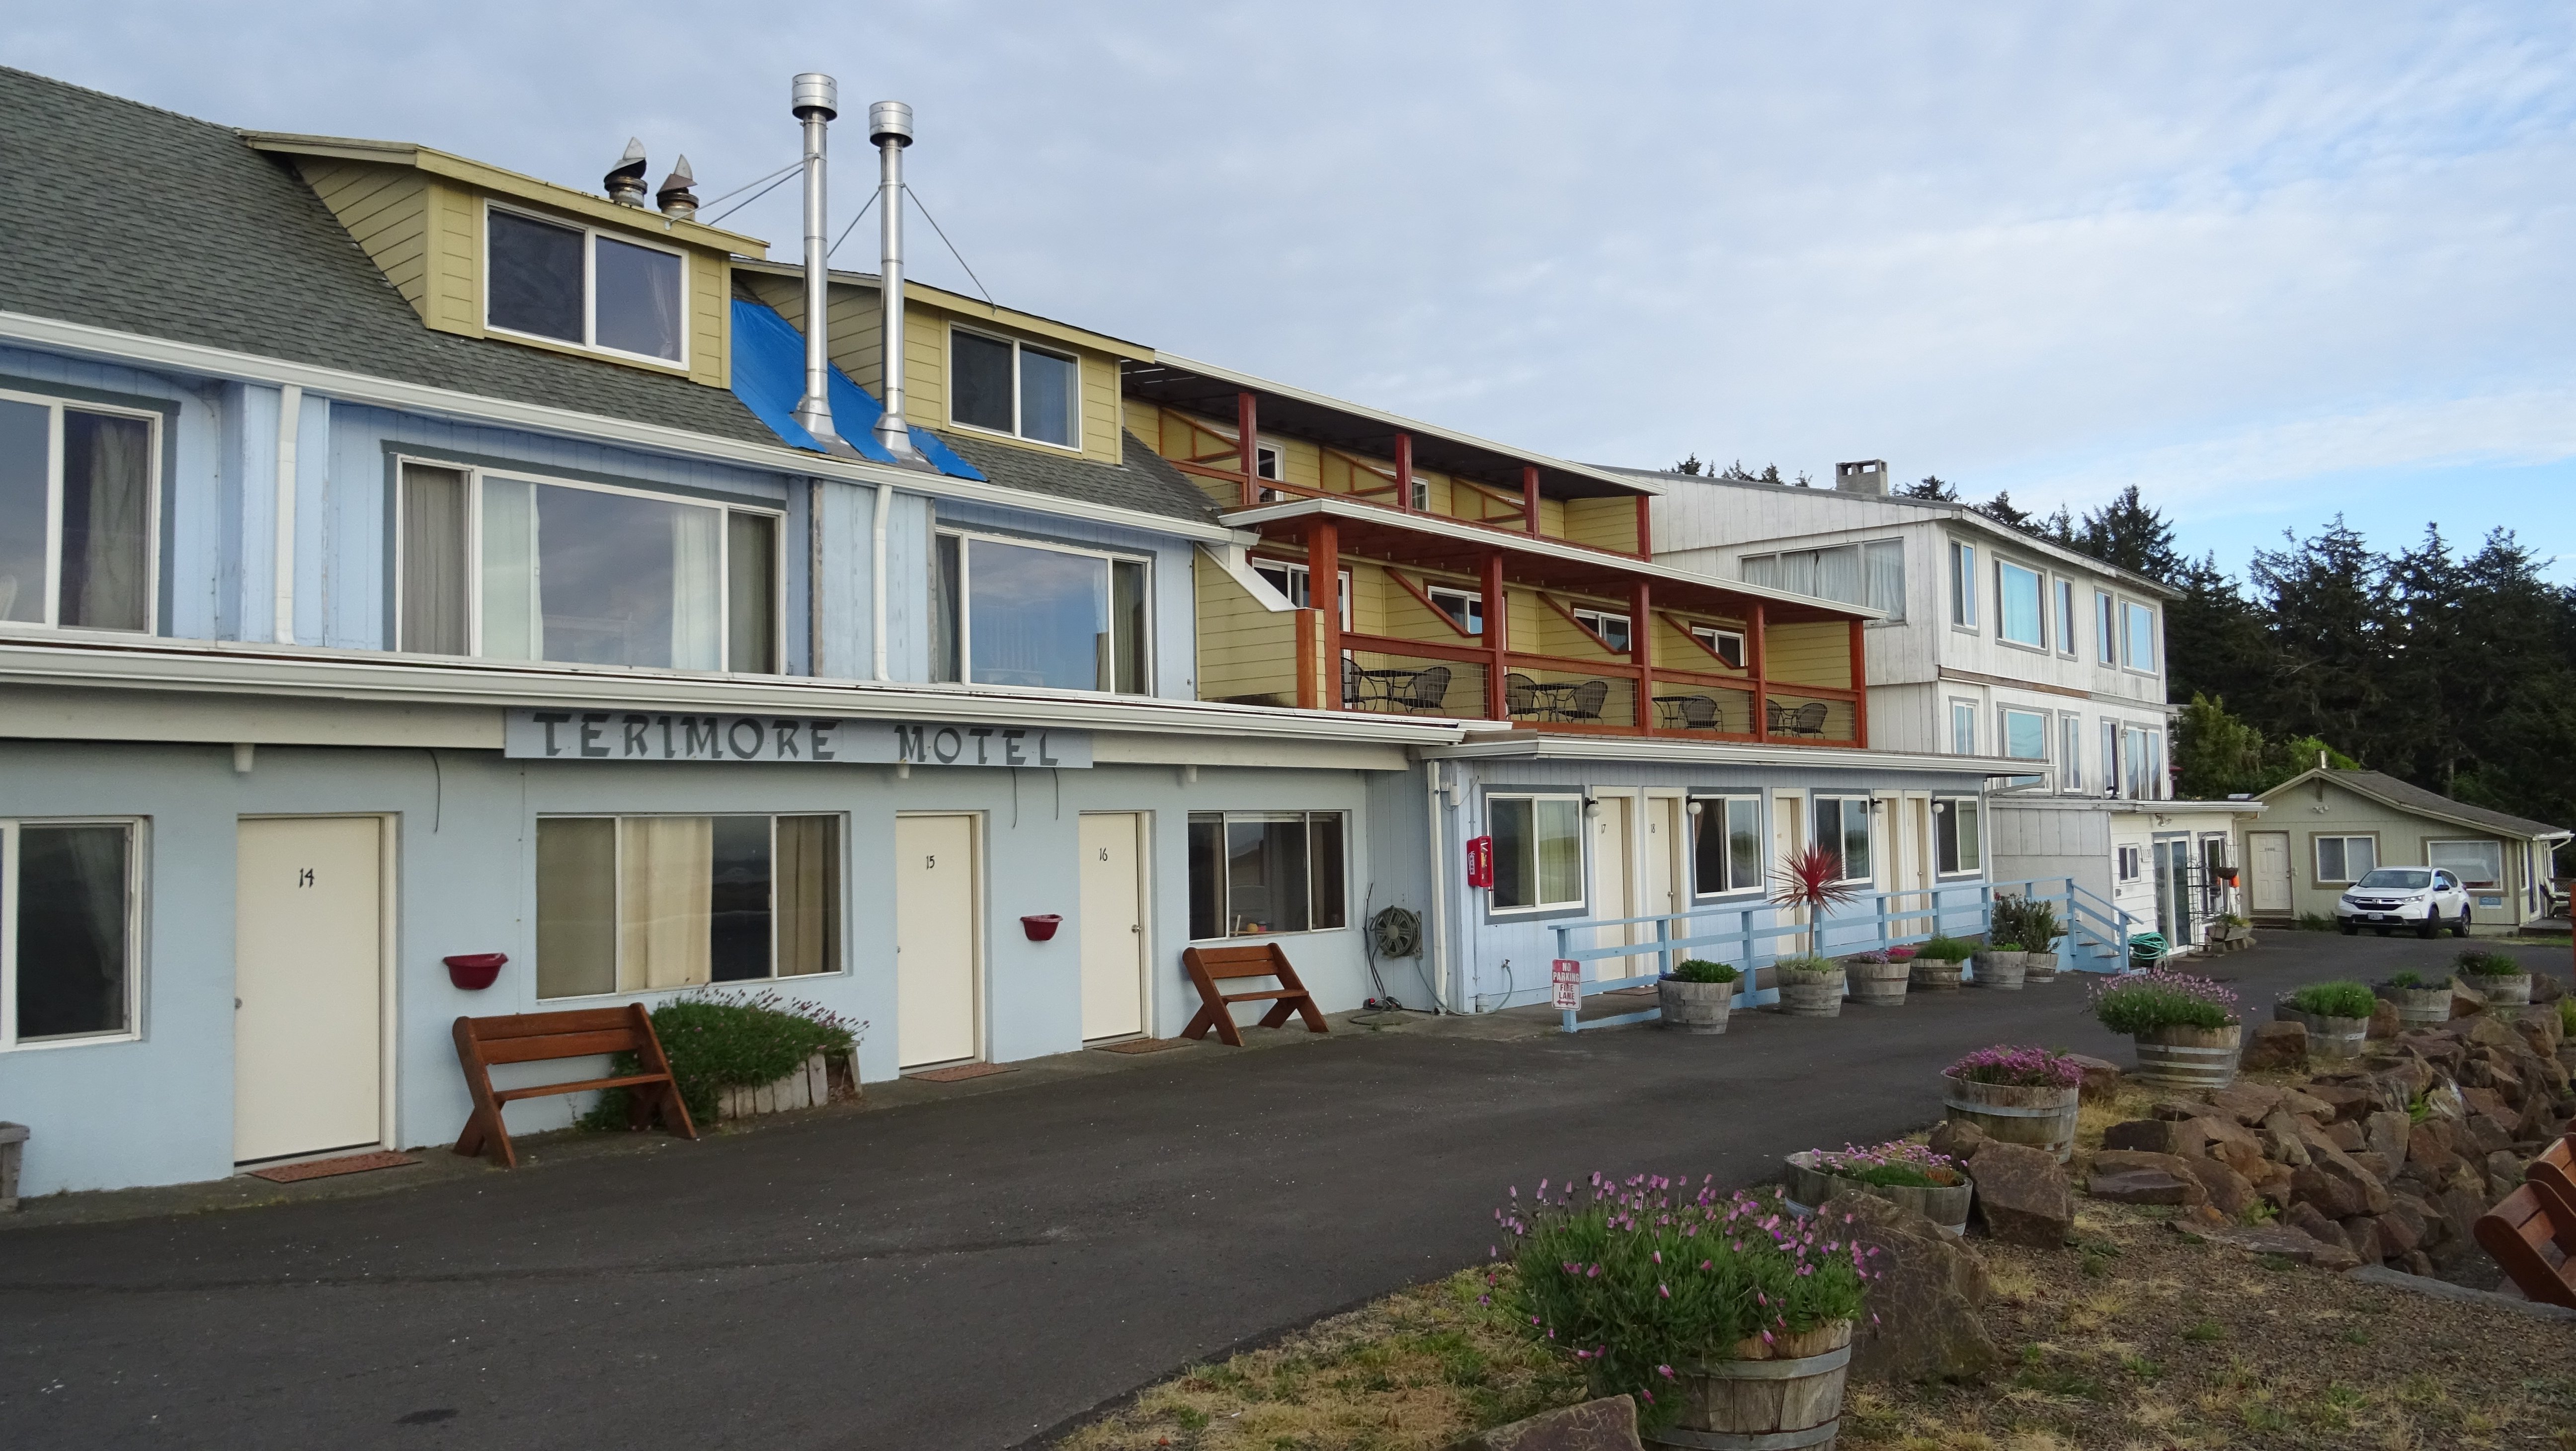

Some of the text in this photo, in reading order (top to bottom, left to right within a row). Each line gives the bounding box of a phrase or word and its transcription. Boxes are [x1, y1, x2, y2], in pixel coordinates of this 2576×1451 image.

[533, 713, 1058, 766] TERIMORE MOTEL
[1601, 824, 1607, 834] 17
[1650, 823, 1656, 834] 18
[1099, 847, 1108, 861] 16
[926, 855, 935, 870] 15
[299, 868, 315, 888] 14
[1562, 962, 1571, 971] NO
[1553, 971, 1580, 982] PARKING
[1560, 984, 1574, 992] FIRE
